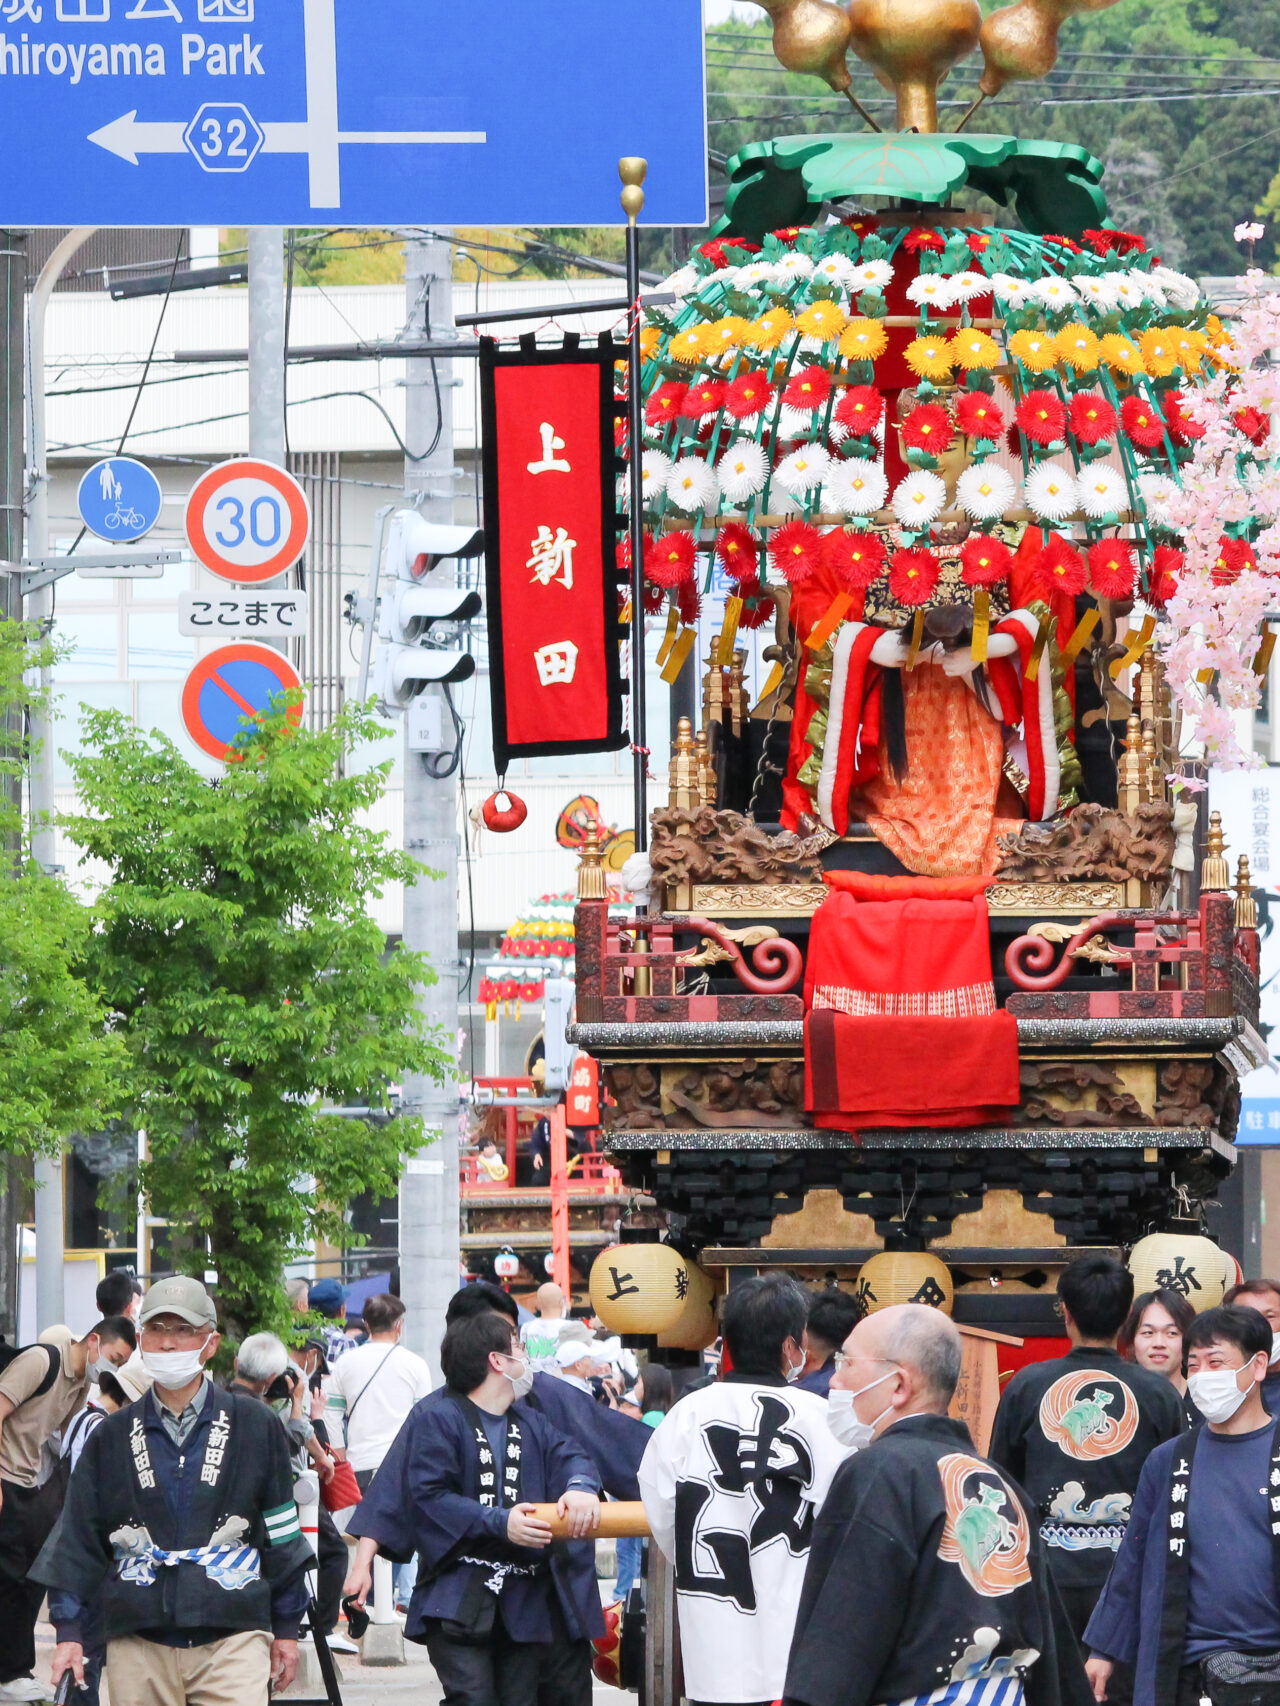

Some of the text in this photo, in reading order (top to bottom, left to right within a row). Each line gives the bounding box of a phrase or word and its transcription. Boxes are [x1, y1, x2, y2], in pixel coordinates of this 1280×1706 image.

[181, 34, 266, 76] Park
[201, 118, 248, 157] 32
[215, 496, 281, 548] 30
[526, 421, 579, 687] 上新田
[190, 601, 296, 627] ここまで
[1252, 787, 1270, 872] 総合宴会場
[129, 1417, 155, 1489] 上新田町
[201, 1410, 230, 1487] 上新田町
[475, 1427, 496, 1508] 上新田町
[504, 1424, 522, 1502] 上新田町
[1169, 1458, 1190, 1557] 上新田町
